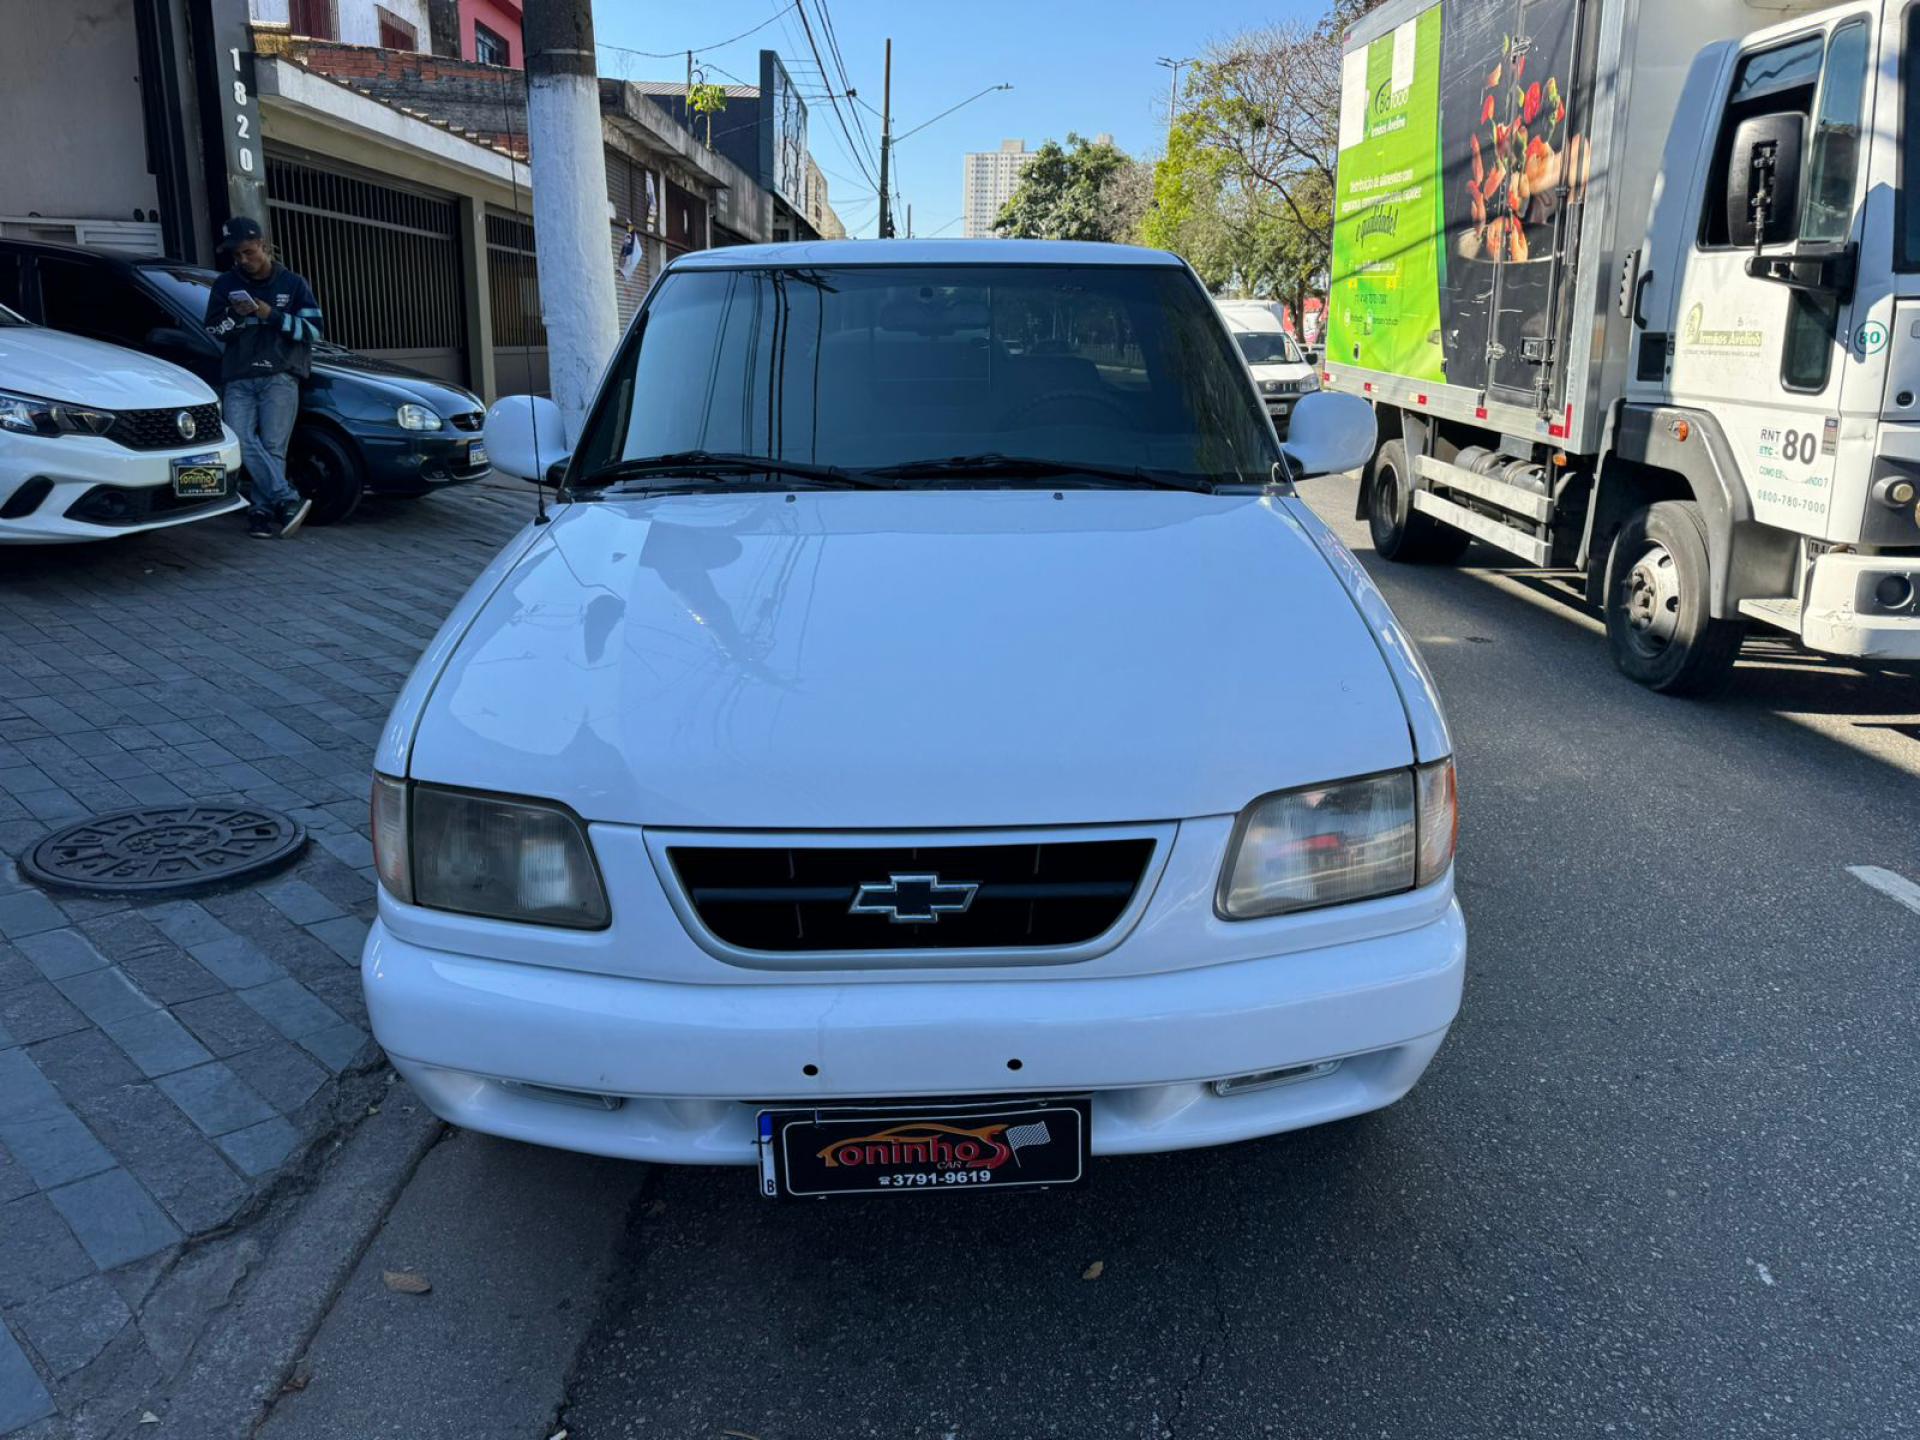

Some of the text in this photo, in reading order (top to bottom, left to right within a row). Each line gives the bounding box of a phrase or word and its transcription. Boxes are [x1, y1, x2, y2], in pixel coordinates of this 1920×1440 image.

[230, 47, 253, 172] 1820
[1782, 428, 1817, 465] 80
[892, 1169, 991, 1186] 3791-9619
